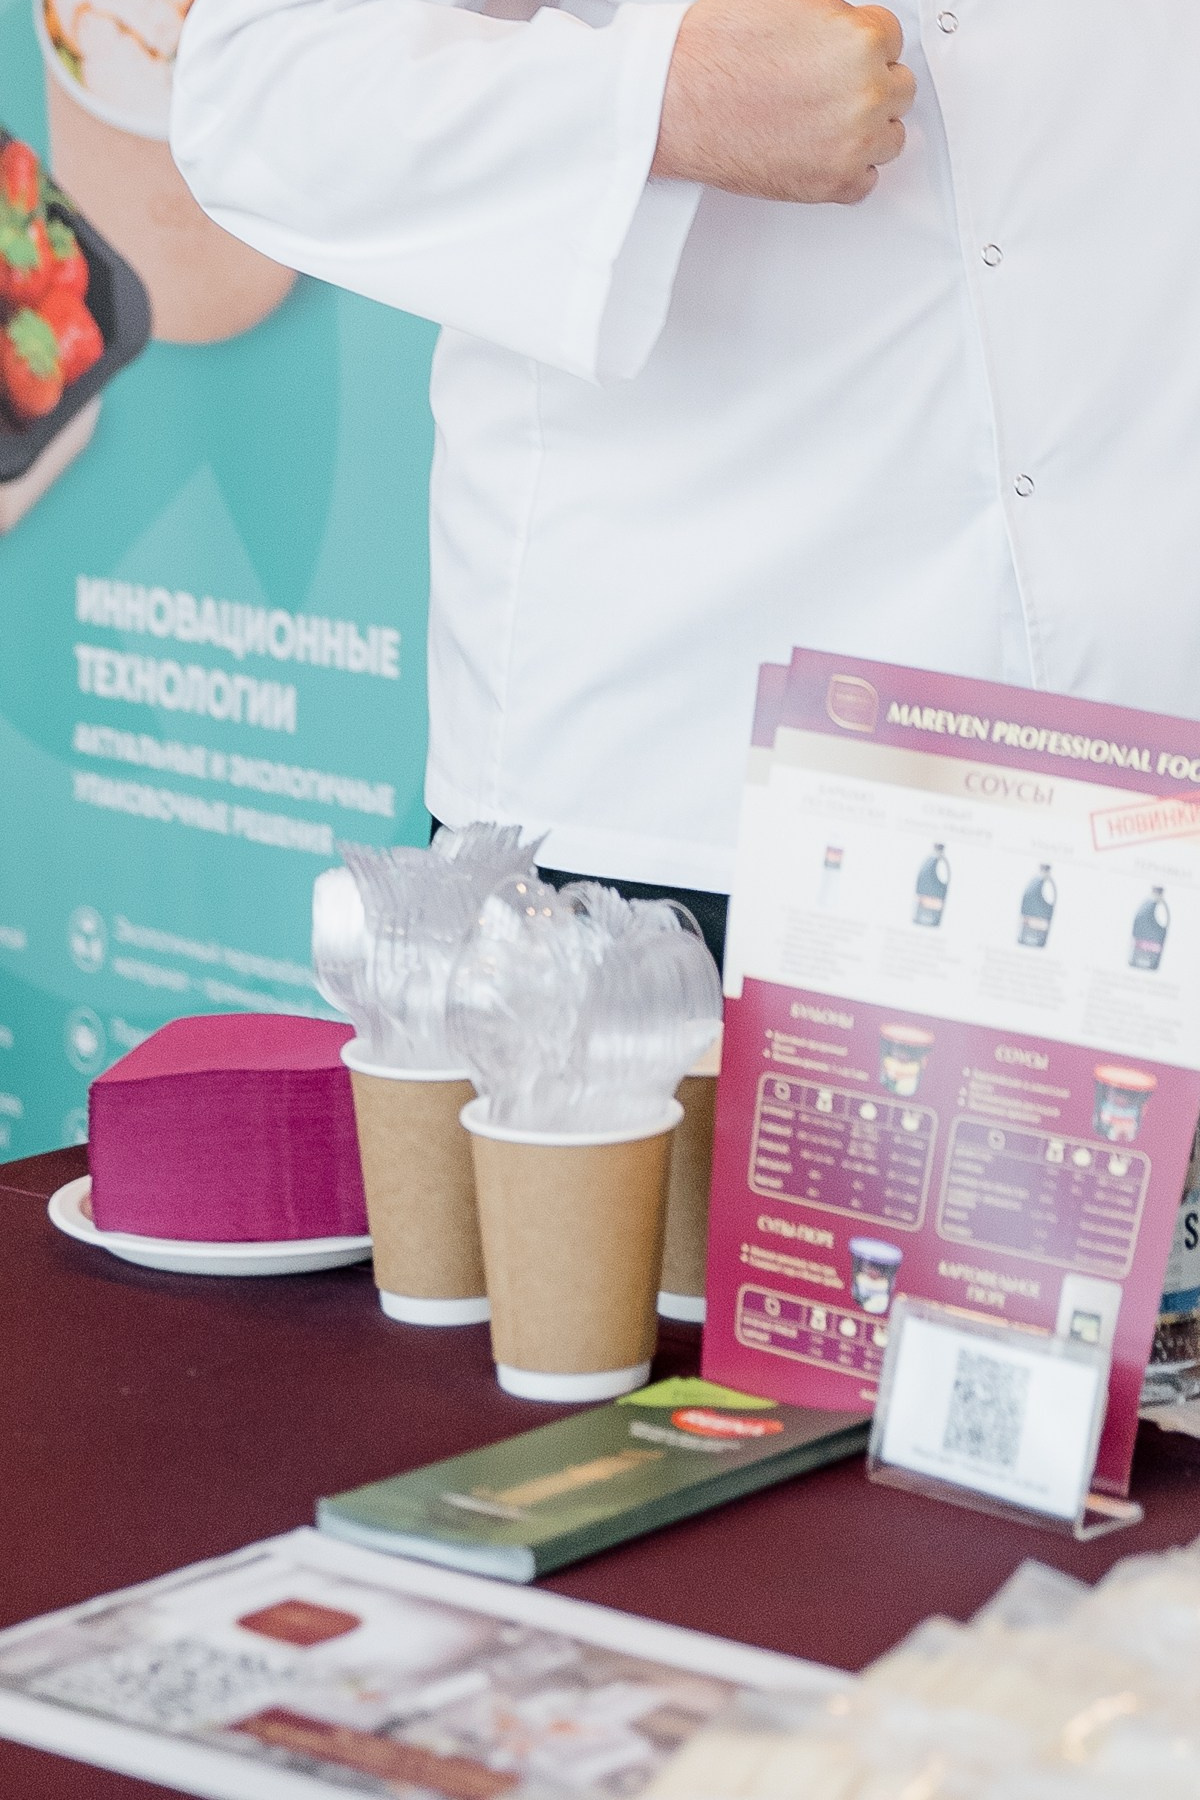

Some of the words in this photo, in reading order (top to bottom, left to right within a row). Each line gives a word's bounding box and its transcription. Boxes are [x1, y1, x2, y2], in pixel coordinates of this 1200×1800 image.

[75, 574, 402, 680] ИННОВАЦИОННЫЕ
[73, 643, 298, 735] ТЕХНОЛОГИИ
[887, 700, 988, 743] MAREVEN
[992, 719, 1152, 775] PROFESSIONAL
[963, 771, 1054, 808] СОУСЫ
